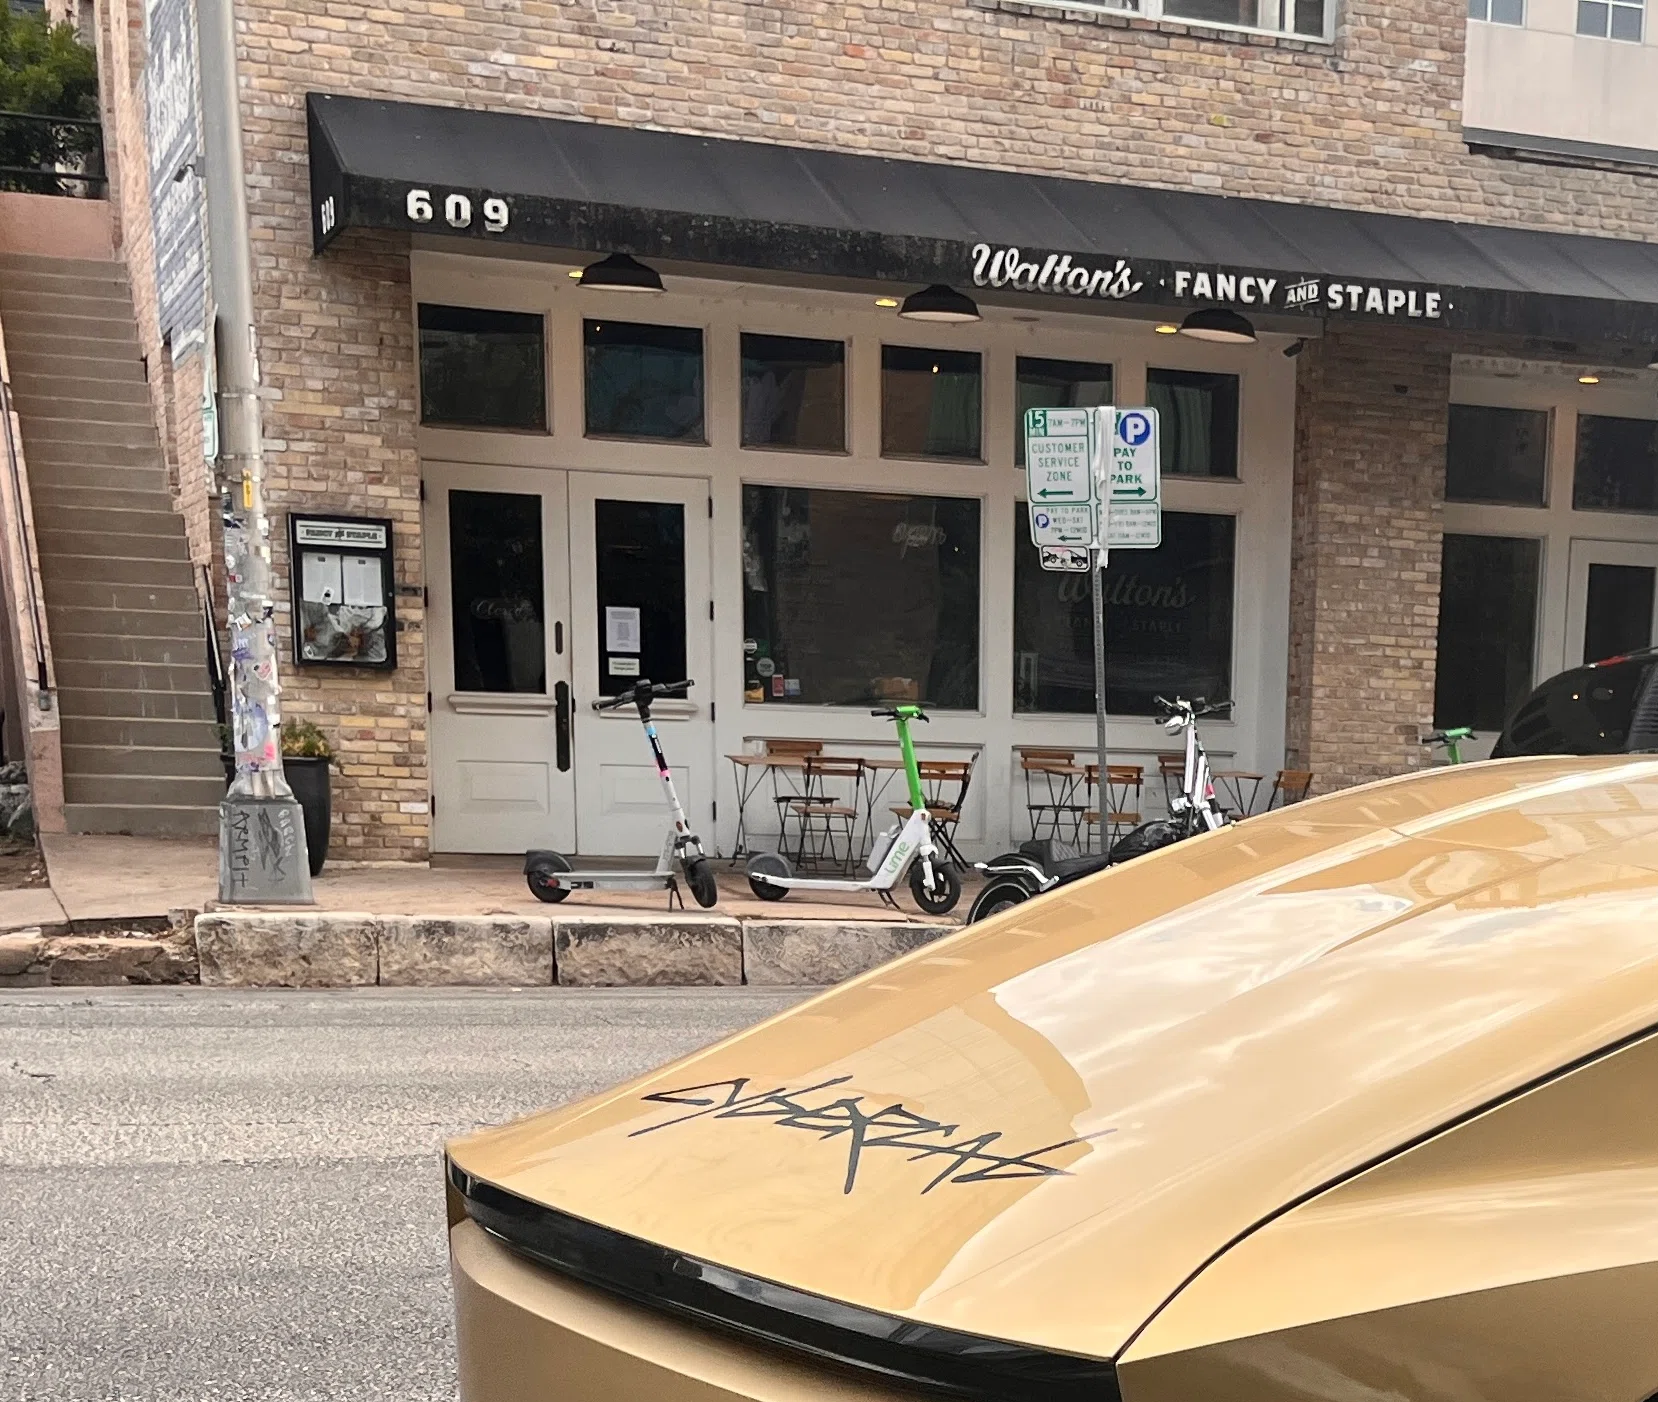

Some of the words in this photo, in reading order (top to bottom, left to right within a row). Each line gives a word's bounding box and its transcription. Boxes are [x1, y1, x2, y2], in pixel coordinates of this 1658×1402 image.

[406, 189, 510, 233] 609
[971, 243, 1144, 299] Walton's
[1174, 270, 1277, 305] FANCY
[1286, 283, 1320, 305] AND
[1327, 283, 1442, 319] STAPLE
[1028, 410, 1045, 428] 15
[1031, 442, 1085, 454] CUSTOMER
[1113, 447, 1137, 458] PAY
[1038, 457, 1080, 468] SERVICE
[1117, 461, 1133, 471] TO
[1046, 471, 1073, 482] ZONE
[1110, 474, 1143, 484] PARK
